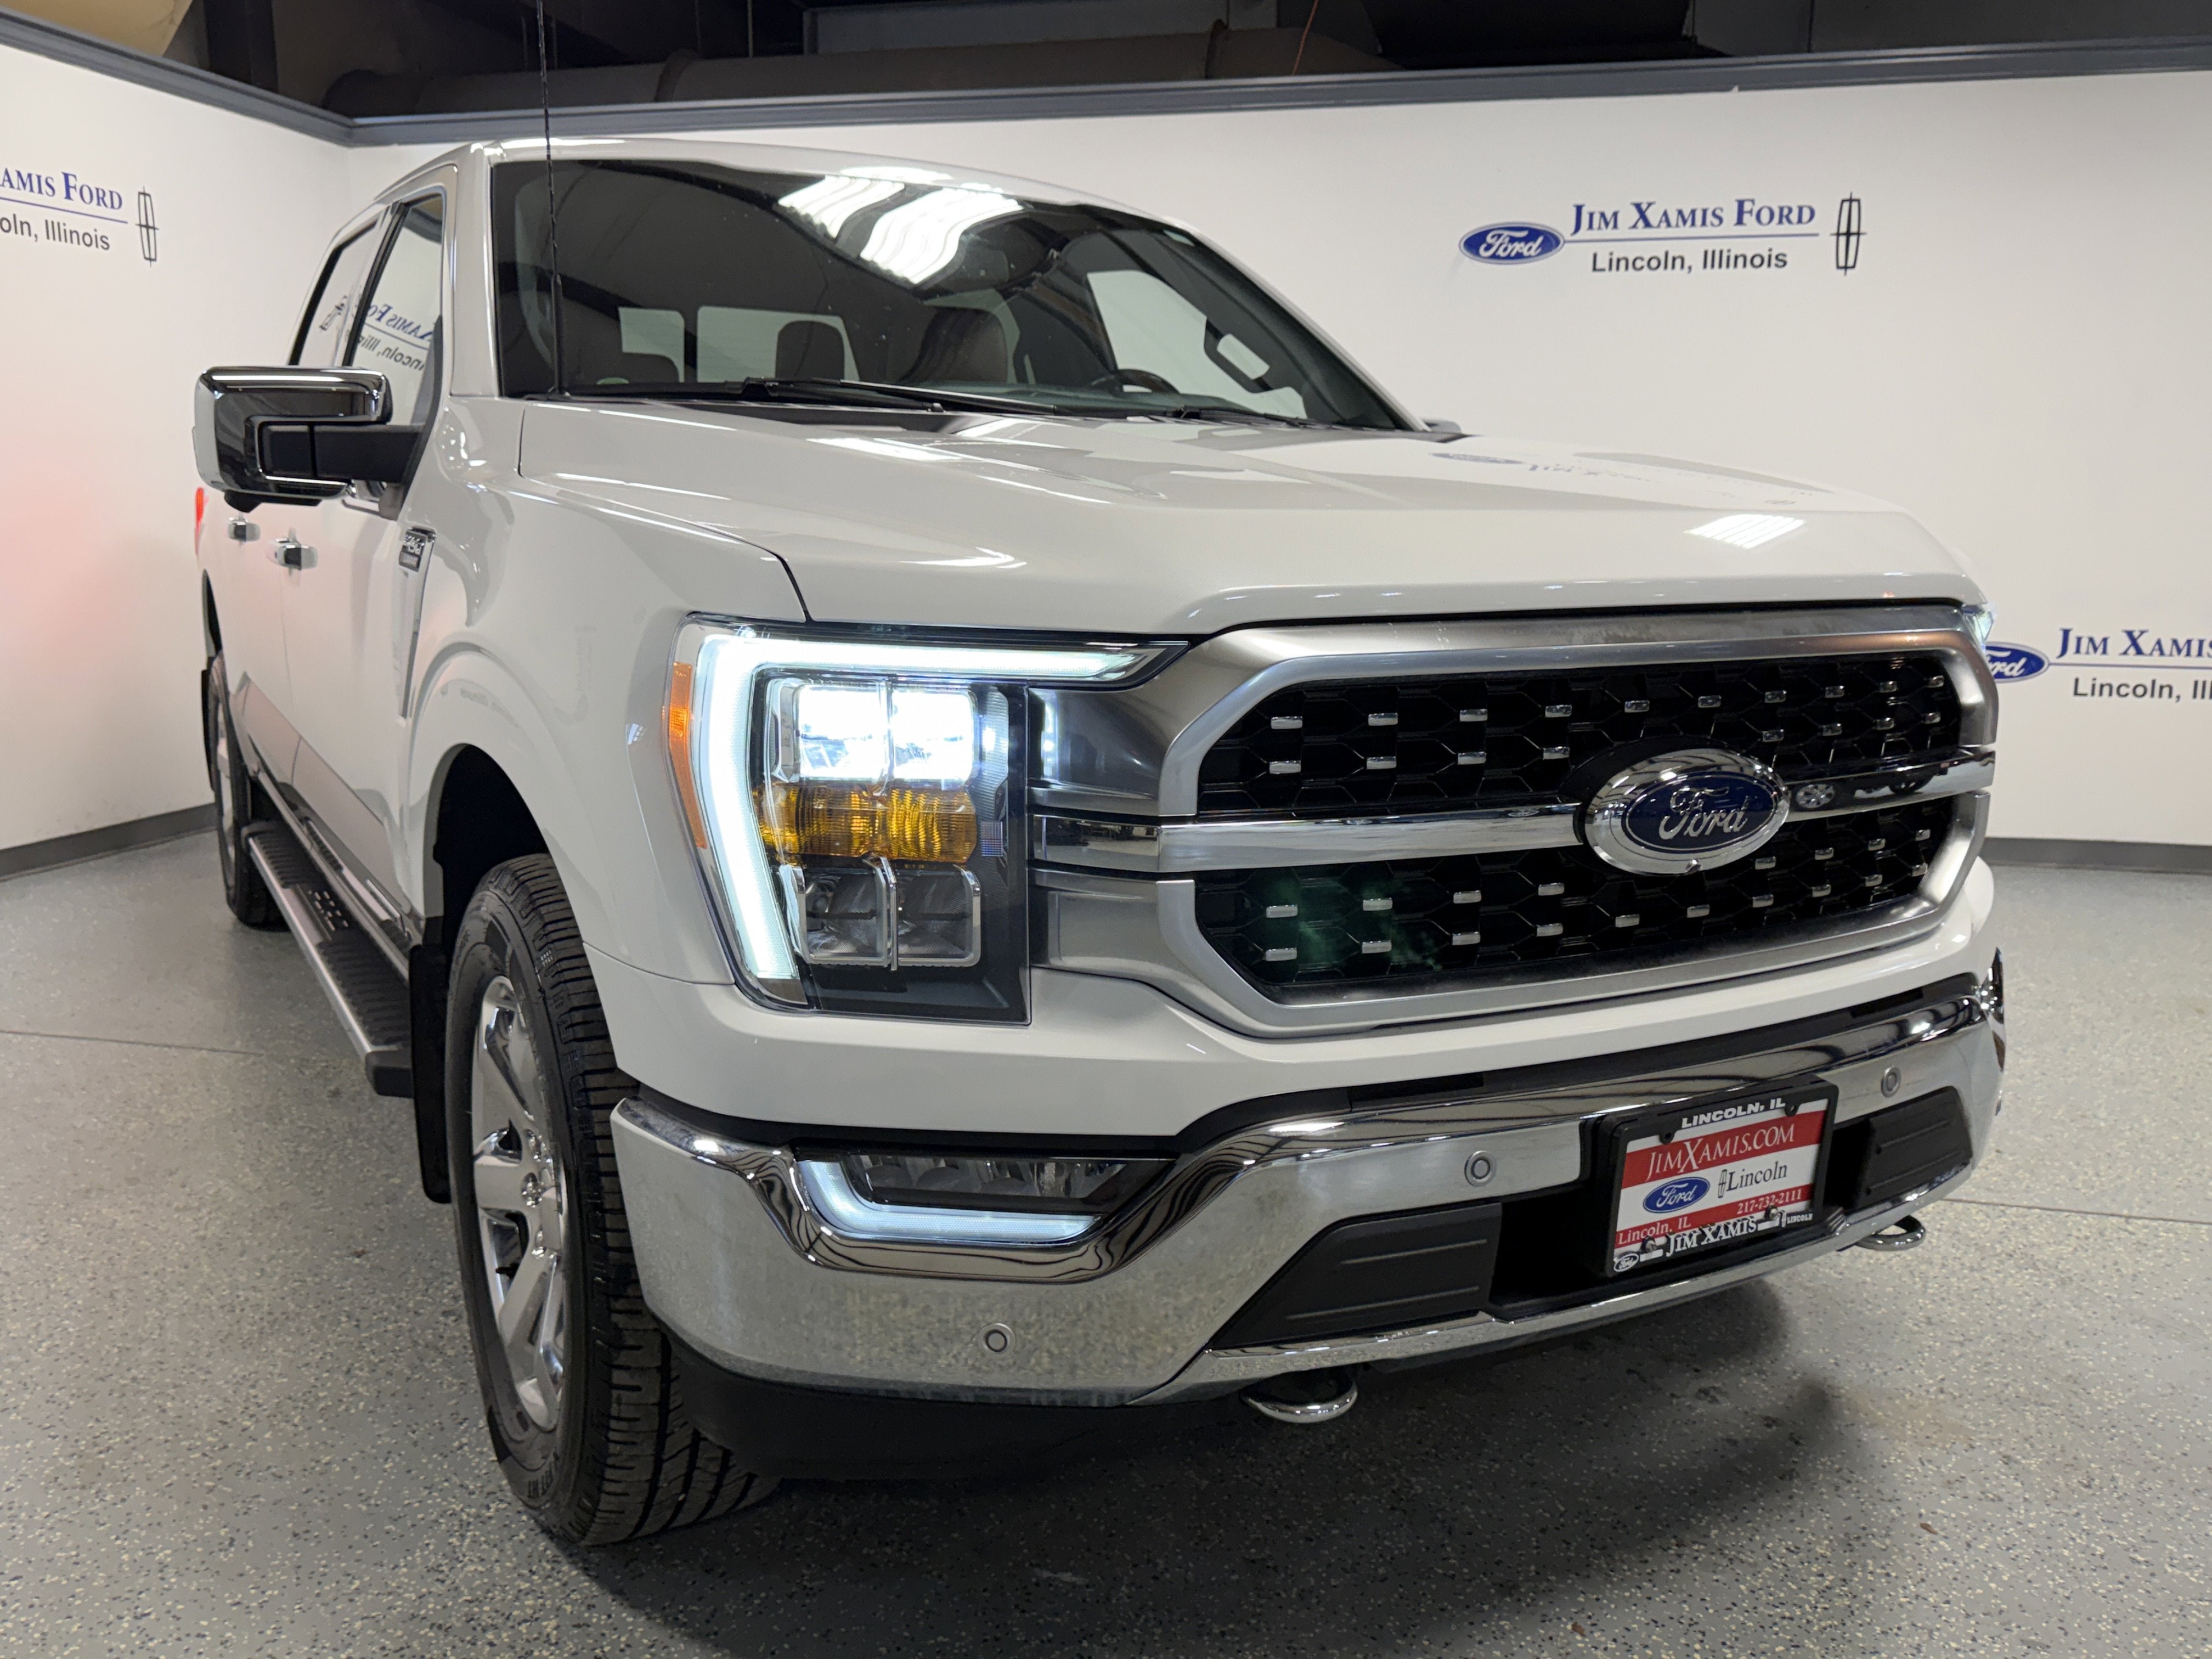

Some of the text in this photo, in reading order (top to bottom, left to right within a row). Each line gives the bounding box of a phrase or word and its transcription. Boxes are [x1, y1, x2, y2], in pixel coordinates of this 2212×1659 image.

[0, 167, 123, 211] AMIS FORD
[1570, 198, 1816, 236] JIM XAMIS FORD
[44, 219, 110, 251] Illinois
[1480, 229, 1541, 259] Ford
[1592, 248, 1788, 273] Lincoln, Illinois
[2056, 628, 2109, 659] JIM
[2073, 677, 2181, 703] Lincoln,
[1658, 787, 1750, 840] Ford
[1681, 1097, 1786, 1128] LINCOLN, IL
[1646, 1123, 1795, 1181] JIMXAMIS.COM
[1726, 1161, 1788, 1191] Lincoln
[1656, 1182, 1697, 1208] Ford
[1737, 1189, 1802, 1215] 217-732-2111
[1666, 1217, 1757, 1257] JIM XAMIS
[1678, 1216, 1691, 1229] IL
